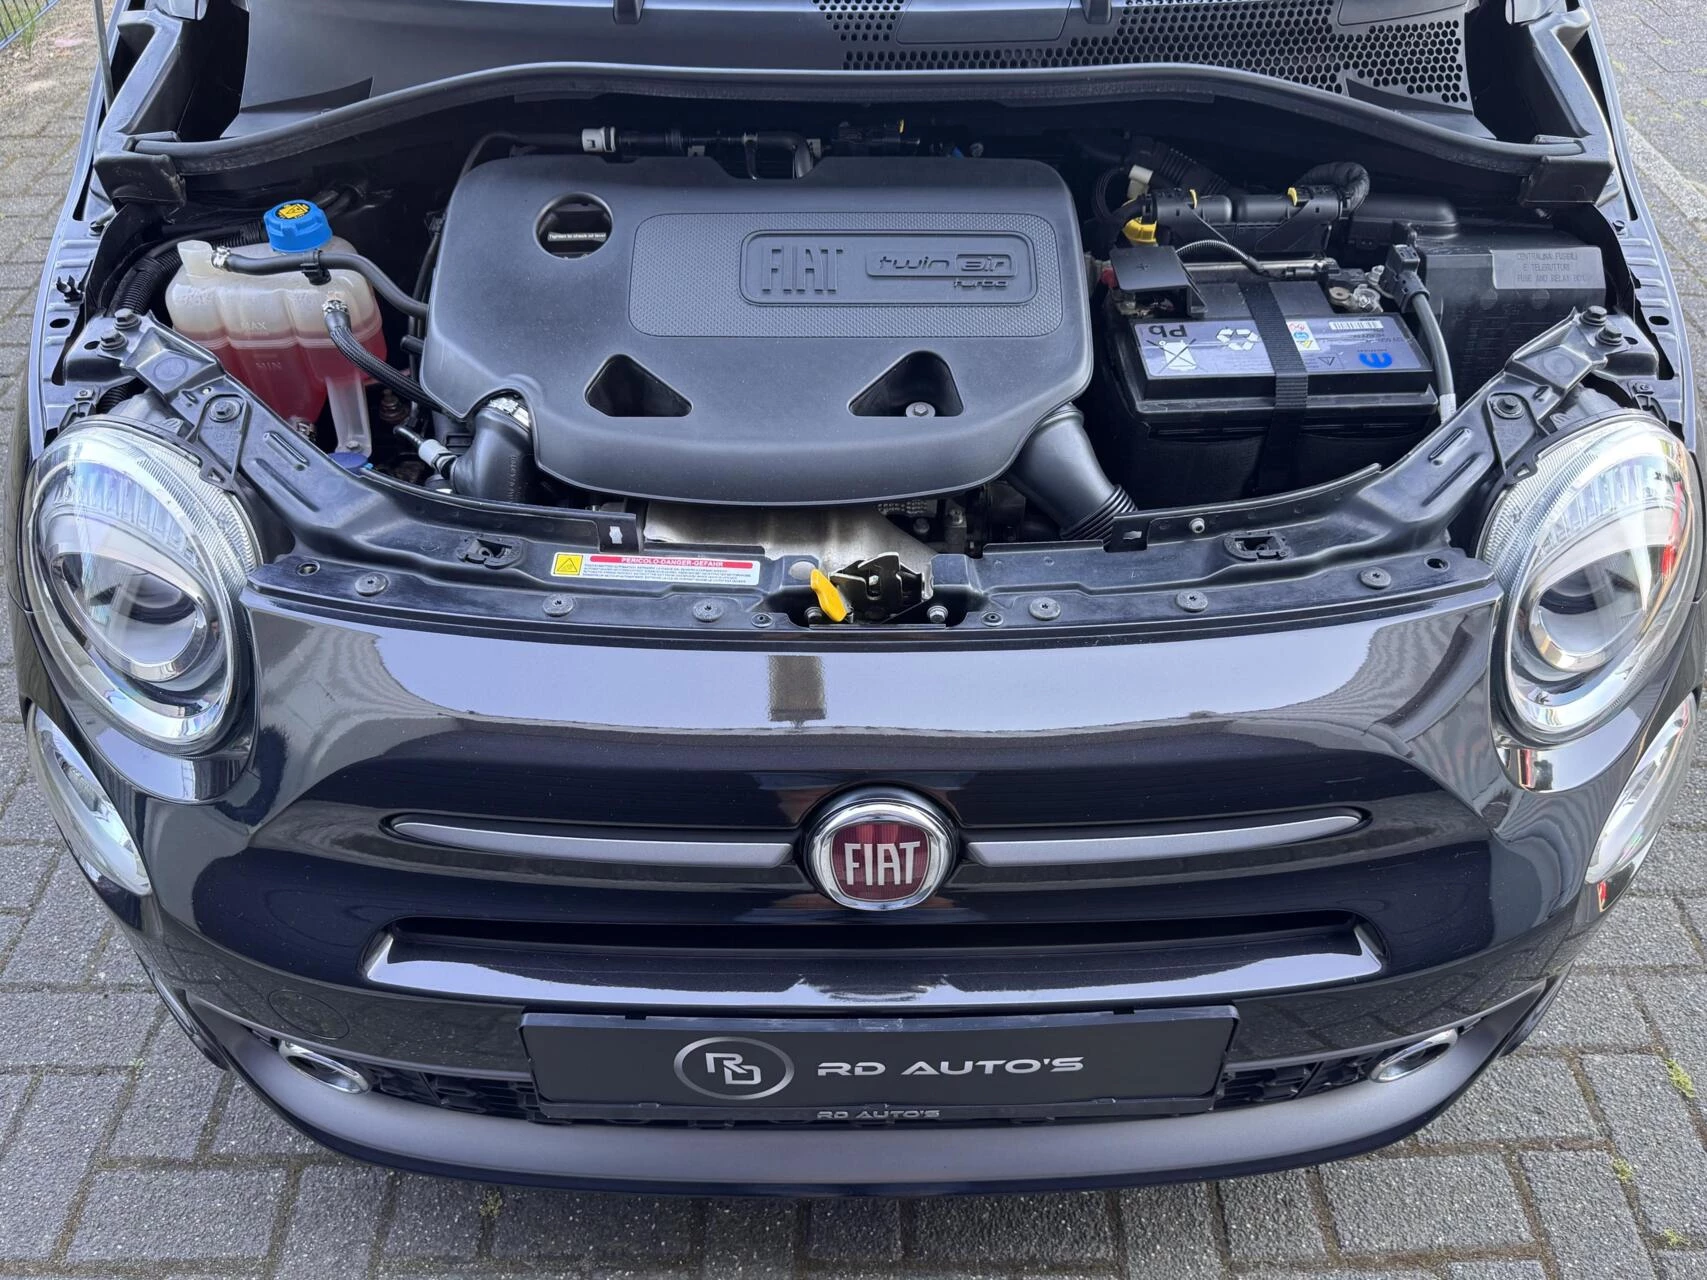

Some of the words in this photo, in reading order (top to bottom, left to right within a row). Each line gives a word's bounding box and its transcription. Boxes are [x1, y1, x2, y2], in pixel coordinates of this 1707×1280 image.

[762, 248, 843, 293] FIAT
[880, 256, 950, 270] twin
[960, 256, 1005, 272] air
[953, 279, 1009, 288] turbo
[1148, 325, 1188, 338] Pb
[844, 841, 920, 886] FIAT
[817, 1061, 886, 1076] RD
[901, 1056, 1085, 1075] AUTO'S
[817, 1110, 849, 1119] RD
[856, 1110, 940, 1119] AUTO'S
